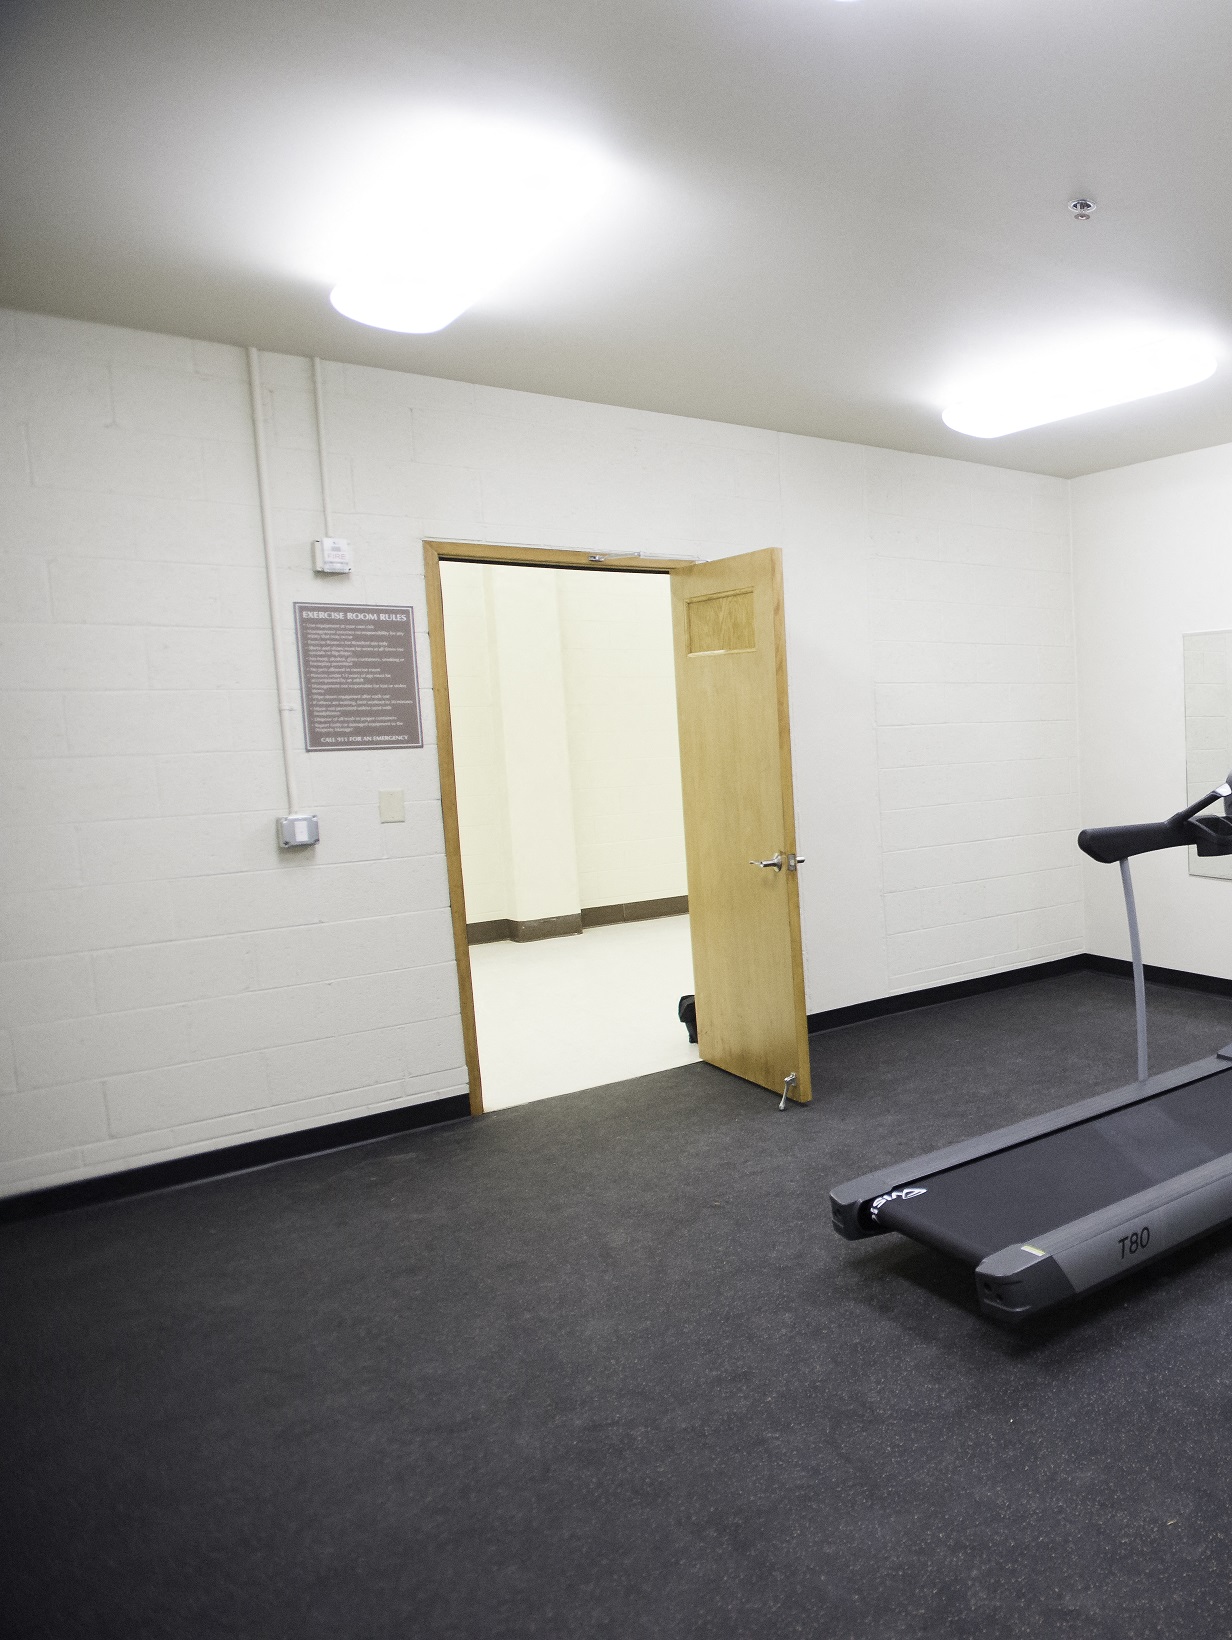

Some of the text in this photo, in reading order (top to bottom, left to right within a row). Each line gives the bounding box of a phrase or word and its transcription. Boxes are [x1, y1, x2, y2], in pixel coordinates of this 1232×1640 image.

[302, 611, 344, 619] EXERCISE
[380, 613, 406, 621] RULES
[1118, 1226, 1150, 1260] T80
